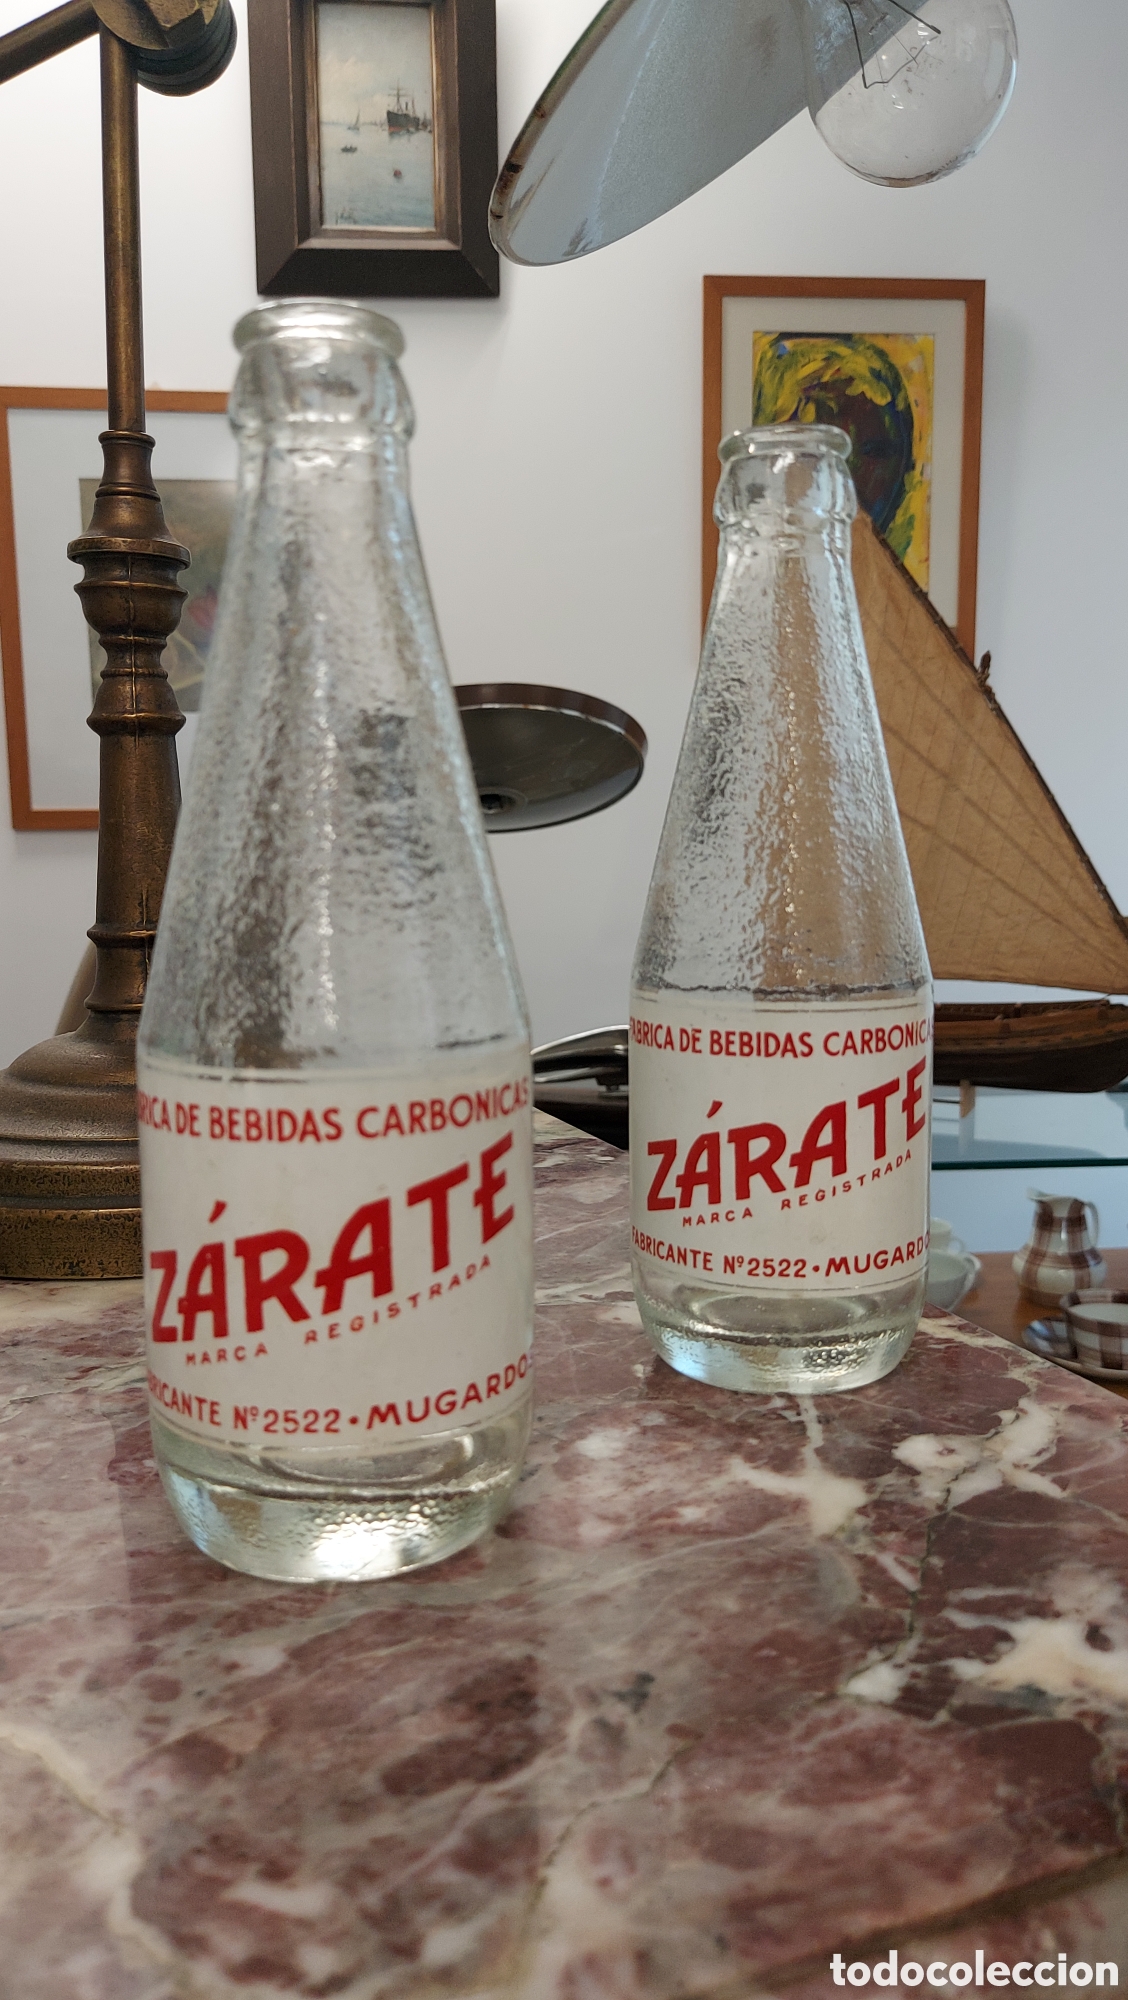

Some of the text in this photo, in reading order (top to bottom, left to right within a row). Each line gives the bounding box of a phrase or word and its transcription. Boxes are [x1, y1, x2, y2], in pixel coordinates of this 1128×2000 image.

[679, 1027, 703, 1053] DE
[709, 1030, 814, 1058] BEBIDAS
[823, 1017, 934, 1056] CARBONICA
[175, 1101, 202, 1137] DE
[209, 1105, 343, 1143] BEBIDAS
[647, 1055, 927, 1211] ZÁRATE
[682, 1148, 912, 1227] MARCA REGISTRADA
[150, 1131, 515, 1343] ZÁRATE
[631, 1225, 714, 1271] FABRICANTE
[186, 1255, 491, 1366] MARCA REGISTRADA
